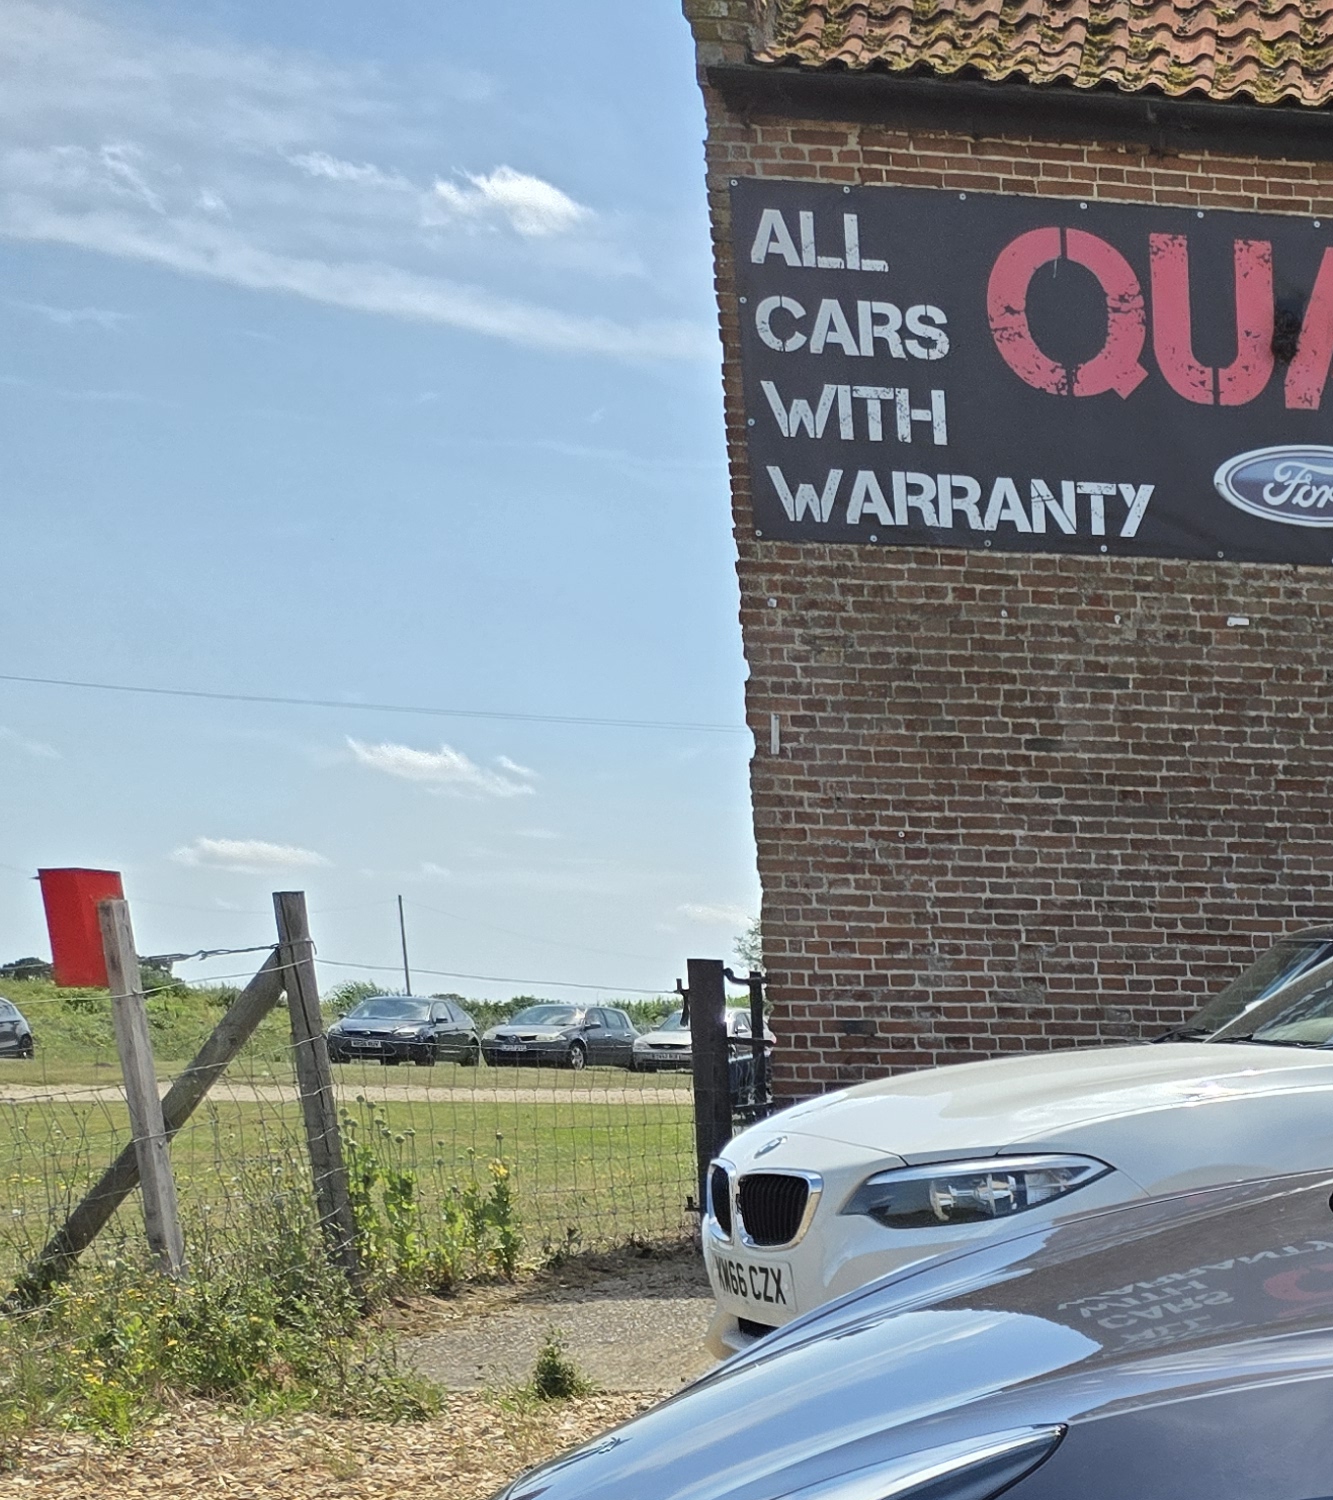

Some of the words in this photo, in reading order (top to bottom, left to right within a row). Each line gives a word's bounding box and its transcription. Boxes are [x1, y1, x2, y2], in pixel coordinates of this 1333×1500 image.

[750, 208, 889, 271] ALL
[755, 295, 950, 360] CARS
[760, 380, 949, 445] WITH
[765, 465, 1155, 538] WARRANTY
[749, 1265, 787, 1305] CZX
